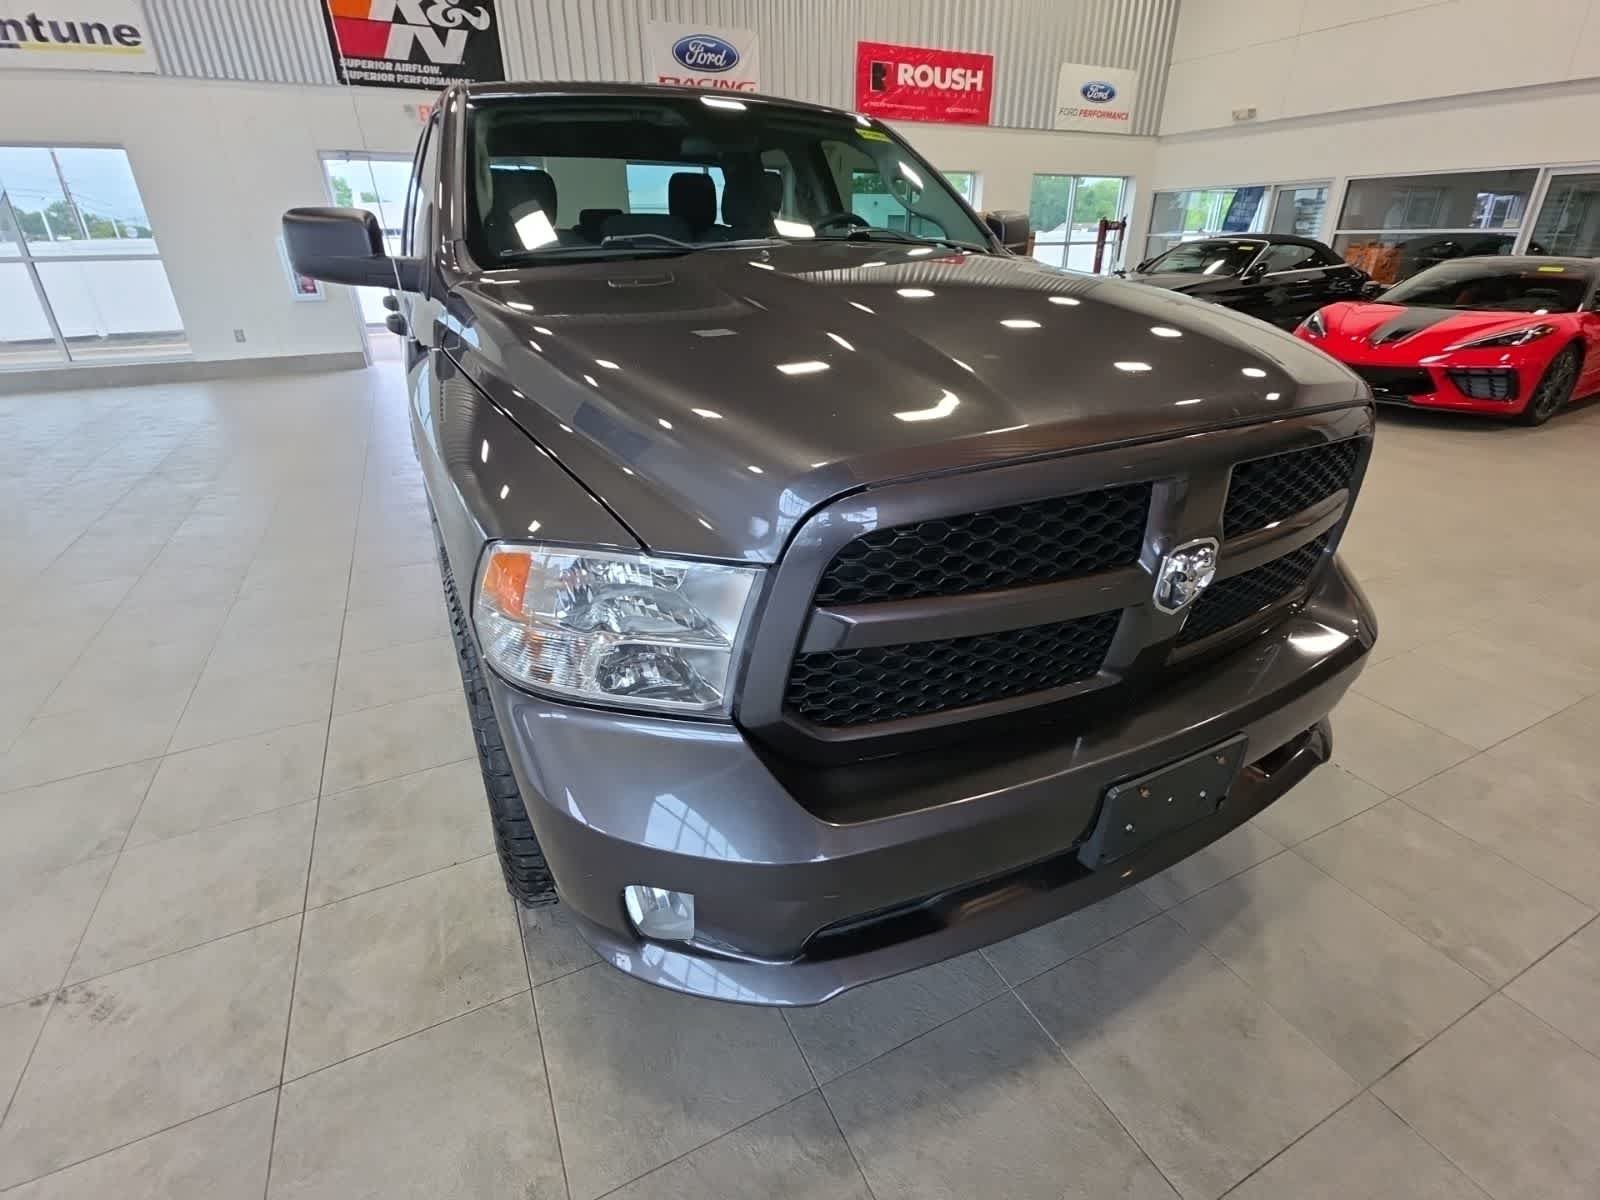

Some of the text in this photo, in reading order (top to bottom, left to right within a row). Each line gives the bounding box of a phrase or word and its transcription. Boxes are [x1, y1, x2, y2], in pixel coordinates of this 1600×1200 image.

[685, 40, 727, 66] Ford
[898, 63, 984, 91] ROUSH
[1087, 84, 1111, 99] Ford
